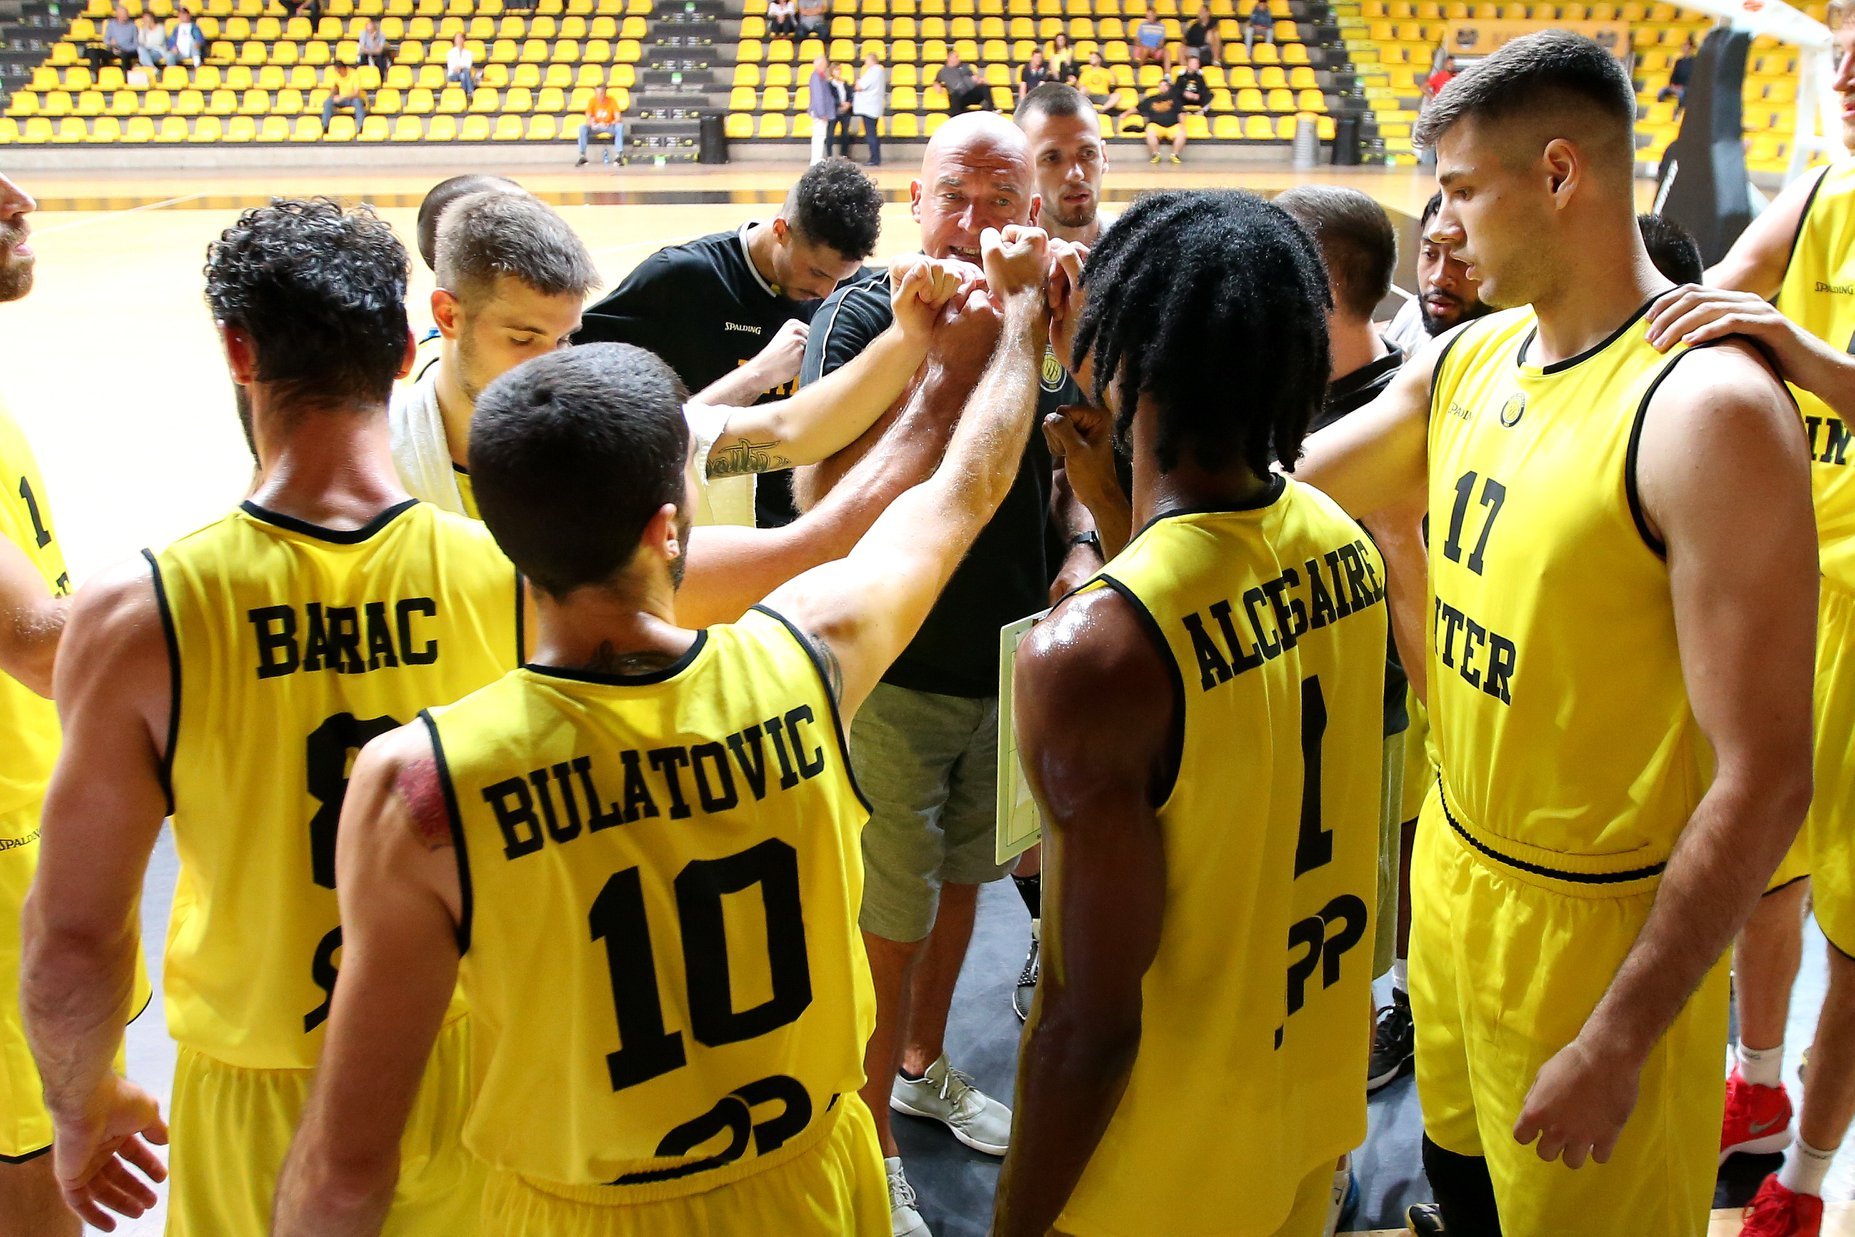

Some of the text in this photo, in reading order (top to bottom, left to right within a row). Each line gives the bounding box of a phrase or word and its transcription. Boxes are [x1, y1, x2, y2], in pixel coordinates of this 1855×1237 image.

[724, 321, 762, 335] SPALDING
[1443, 470, 1507, 577] 17
[247, 597, 438, 680] BARAC
[481, 703, 826, 861] BULATOVIC
[588, 836, 814, 1093] 10
